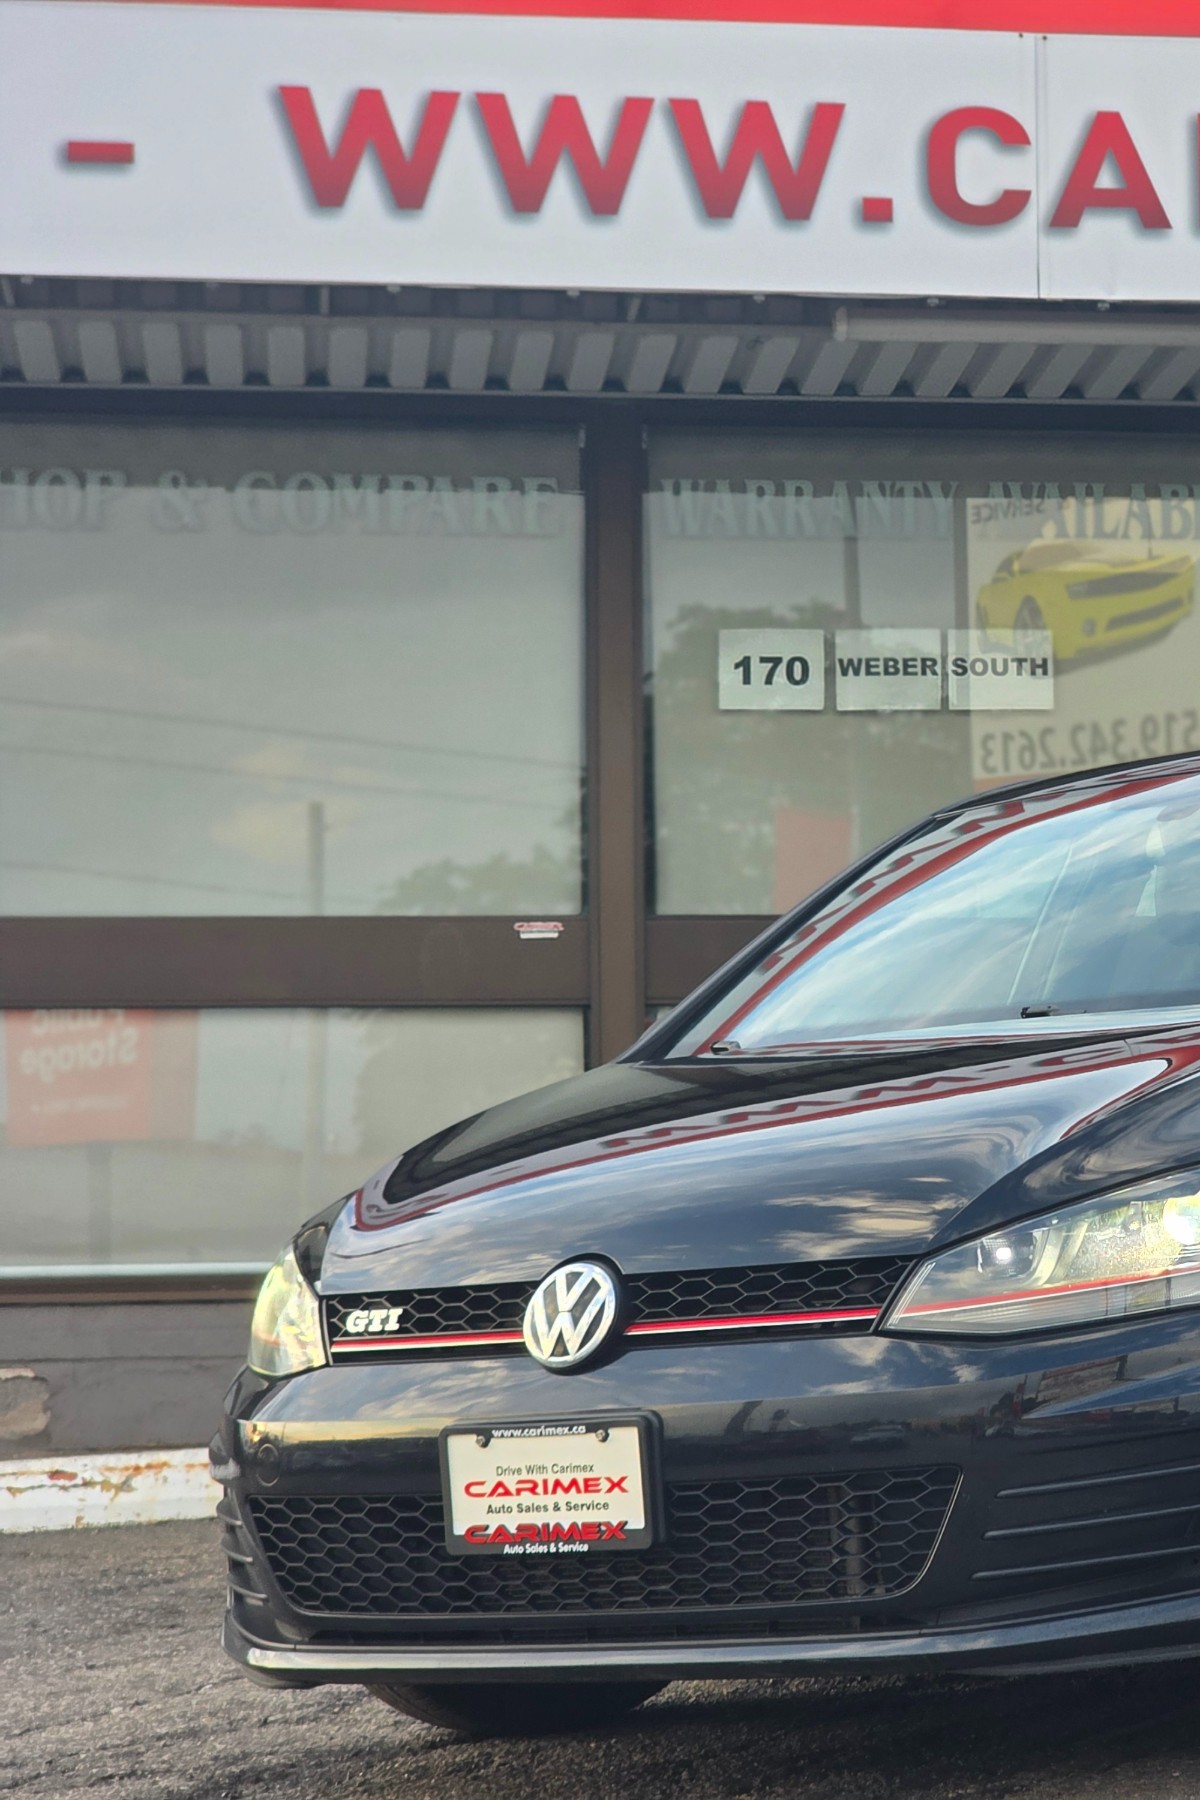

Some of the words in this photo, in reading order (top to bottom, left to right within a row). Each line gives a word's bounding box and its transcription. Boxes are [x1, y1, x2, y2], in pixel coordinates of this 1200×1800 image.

[150, 468, 208, 533] &
[233, 471, 564, 536] COMPARE
[661, 478, 958, 539] WARRANTY
[733, 655, 810, 686] 170
[838, 656, 939, 678] WEBER
[951, 656, 1049, 678] SOUTH
[344, 1307, 404, 1334] GTI
[491, 1425, 587, 1438] www.carimex.ca
[496, 1464, 523, 1476] Drive
[525, 1463, 549, 1475] With
[551, 1462, 595, 1474] Carimex
[464, 1475, 629, 1498] CARIMEX
[486, 1503, 513, 1515] Auto
[516, 1502, 549, 1514] Sales
[552, 1501, 562, 1512] &
[565, 1500, 610, 1512] Service
[463, 1520, 629, 1544] CARIMEX
[503, 1542, 525, 1555] Auto
[525, 1541, 549, 1554] Sales
[549, 1542, 558, 1552] &
[558, 1540, 589, 1553] Service
